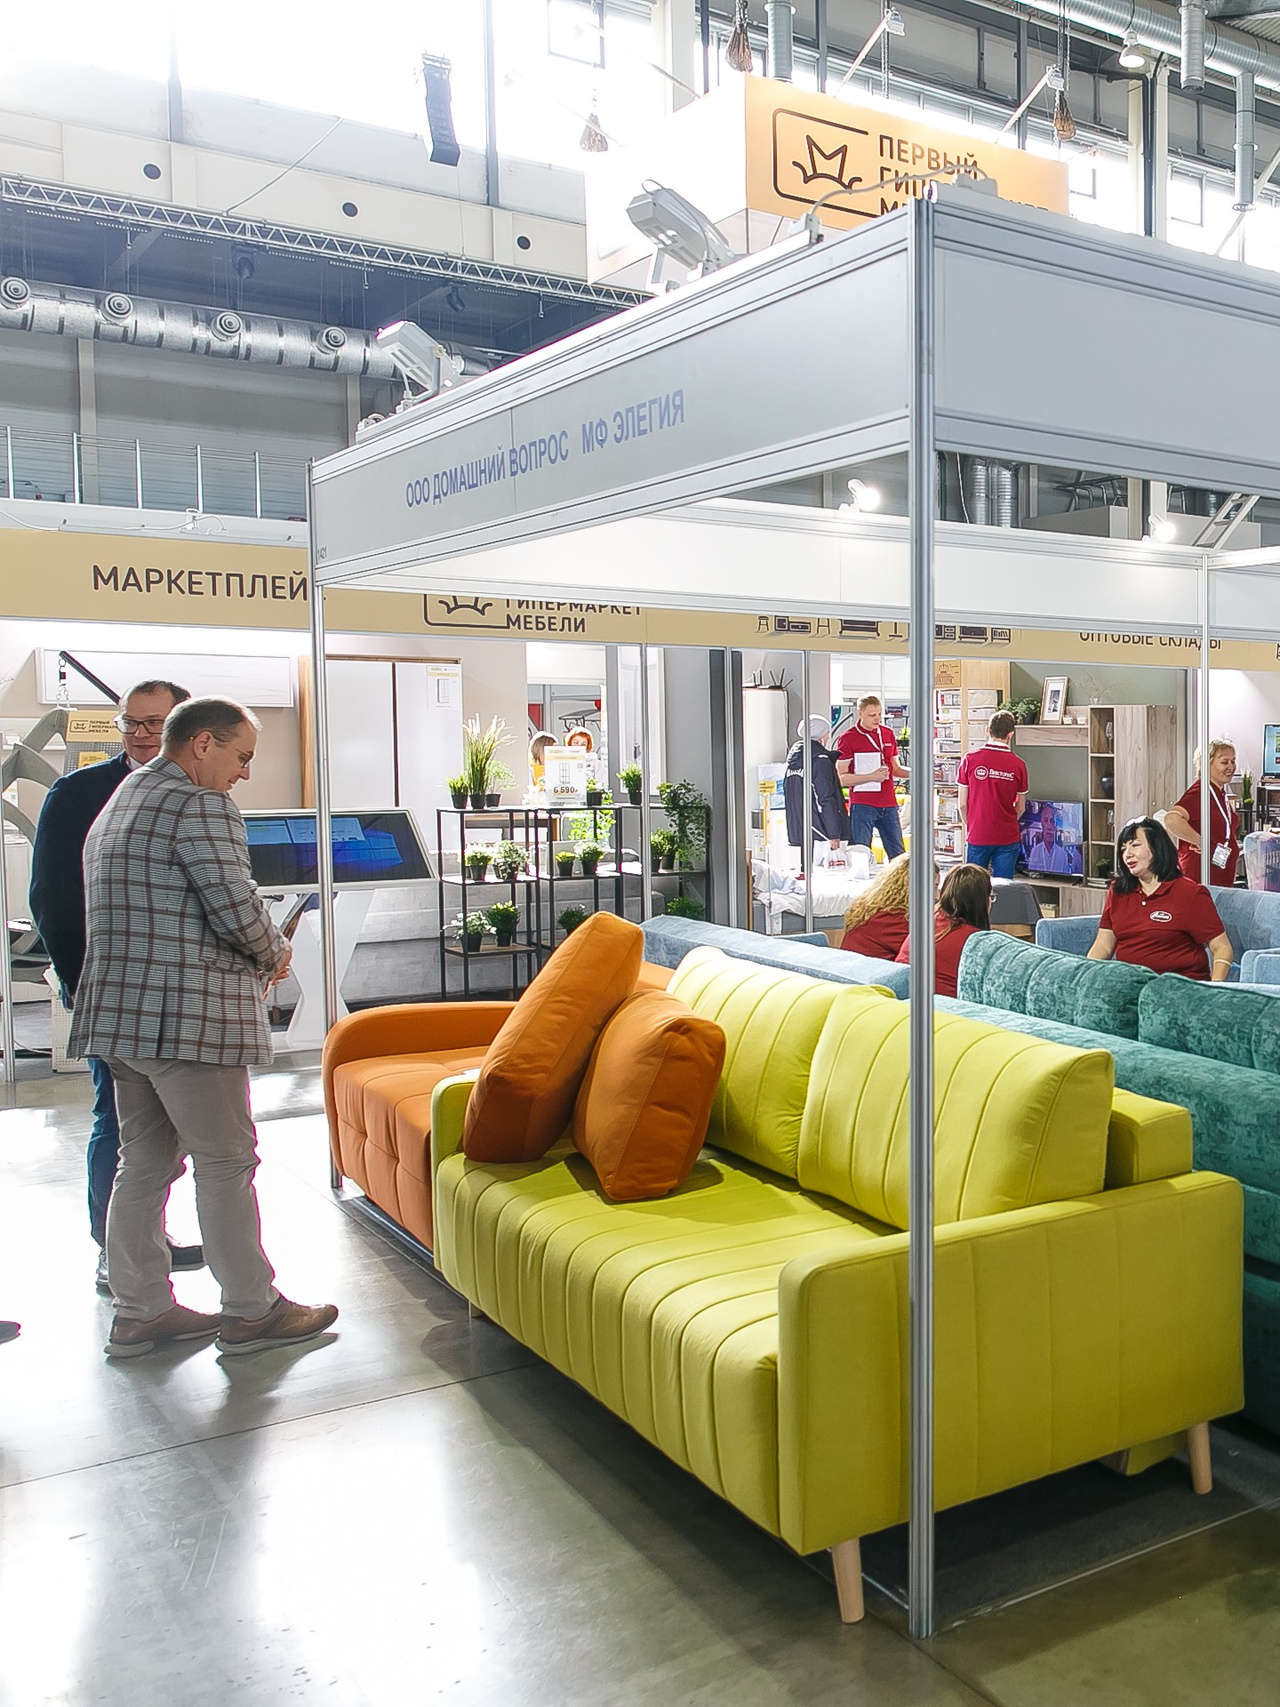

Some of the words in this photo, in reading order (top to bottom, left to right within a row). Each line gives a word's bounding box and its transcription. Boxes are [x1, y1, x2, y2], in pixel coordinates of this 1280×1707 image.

[879, 134, 978, 179] ПЕРВЫЙ
[406, 481, 430, 508] ООО
[433, 445, 506, 505] ДОМАШНИЙ
[510, 430, 569, 477] ВОПРОС
[582, 417, 608, 454] МФ
[613, 389, 684, 444] ЭЛЕГИЯ
[92, 564, 311, 601] МАРКЕТПЛЕЙ
[505, 613, 586, 633] МЕБЕЛИ
